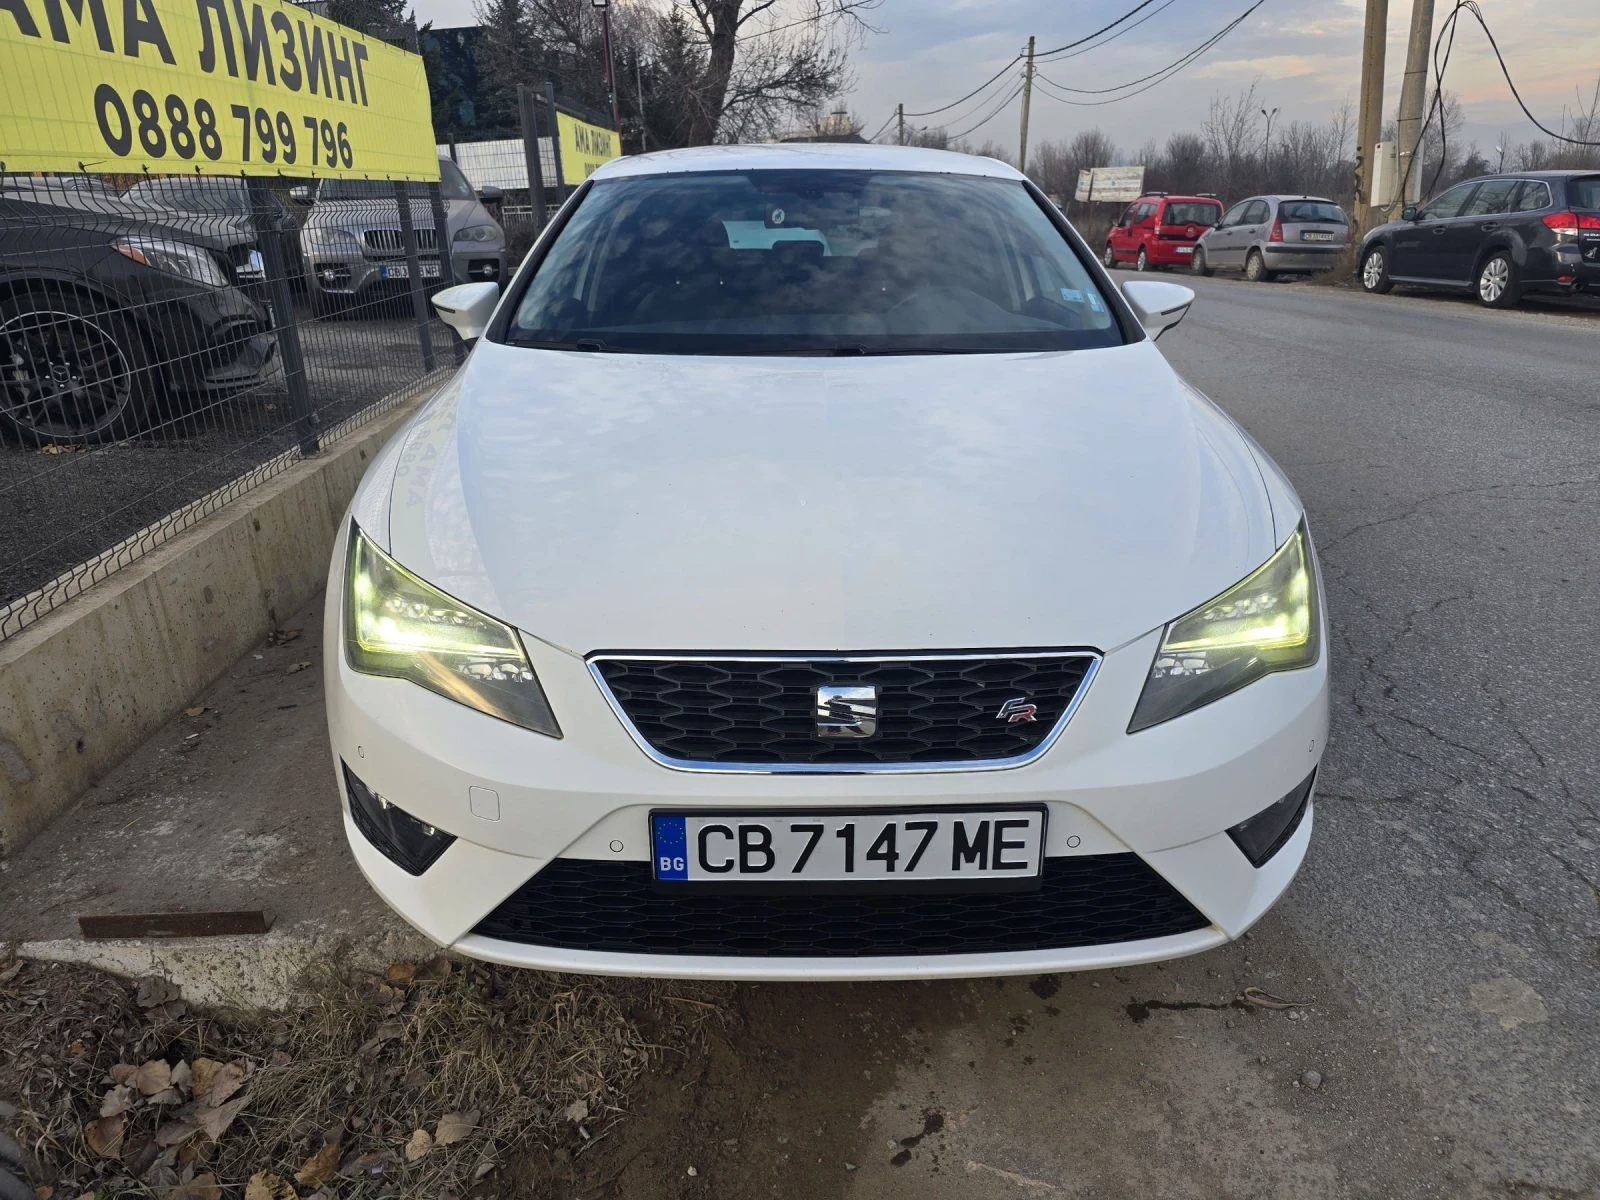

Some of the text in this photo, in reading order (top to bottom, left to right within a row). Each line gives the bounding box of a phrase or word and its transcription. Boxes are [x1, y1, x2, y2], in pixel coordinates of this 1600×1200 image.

[197, 0, 368, 107] ЛИЗИНГ
[94, 83, 353, 169] 0888 799 796
[996, 697, 1037, 722] FR
[660, 856, 685, 872] BG
[697, 819, 1030, 873] CB 7147 ME
